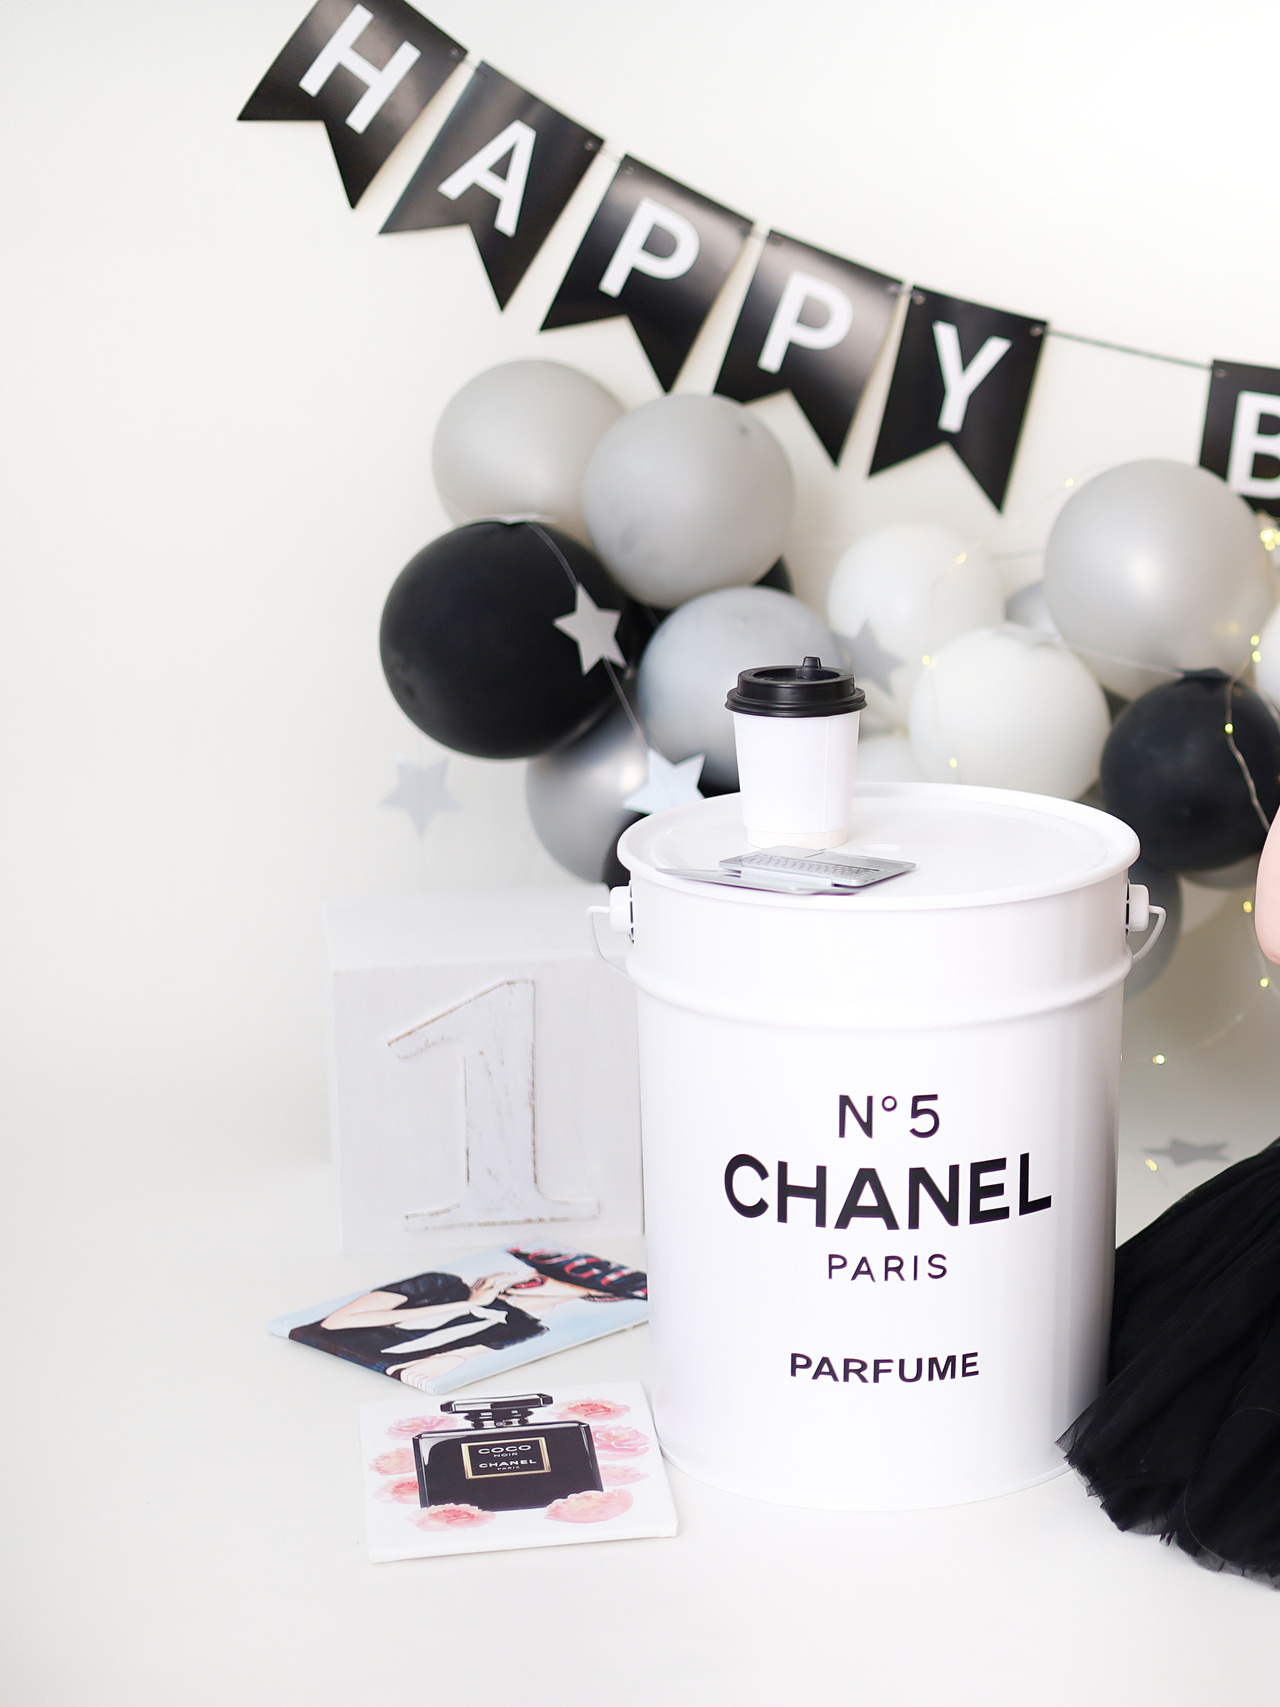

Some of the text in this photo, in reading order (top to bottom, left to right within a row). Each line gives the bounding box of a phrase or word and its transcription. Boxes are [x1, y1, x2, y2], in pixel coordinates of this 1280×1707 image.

[298, 3, 1012, 434] HAPPY
[723, 1152, 1053, 1231] CHANEL
[828, 1253, 948, 1283] PARIS
[790, 1351, 980, 1383] PARFUME
[478, 1444, 532, 1454] COCO
[478, 1459, 537, 1468] CHANEL
